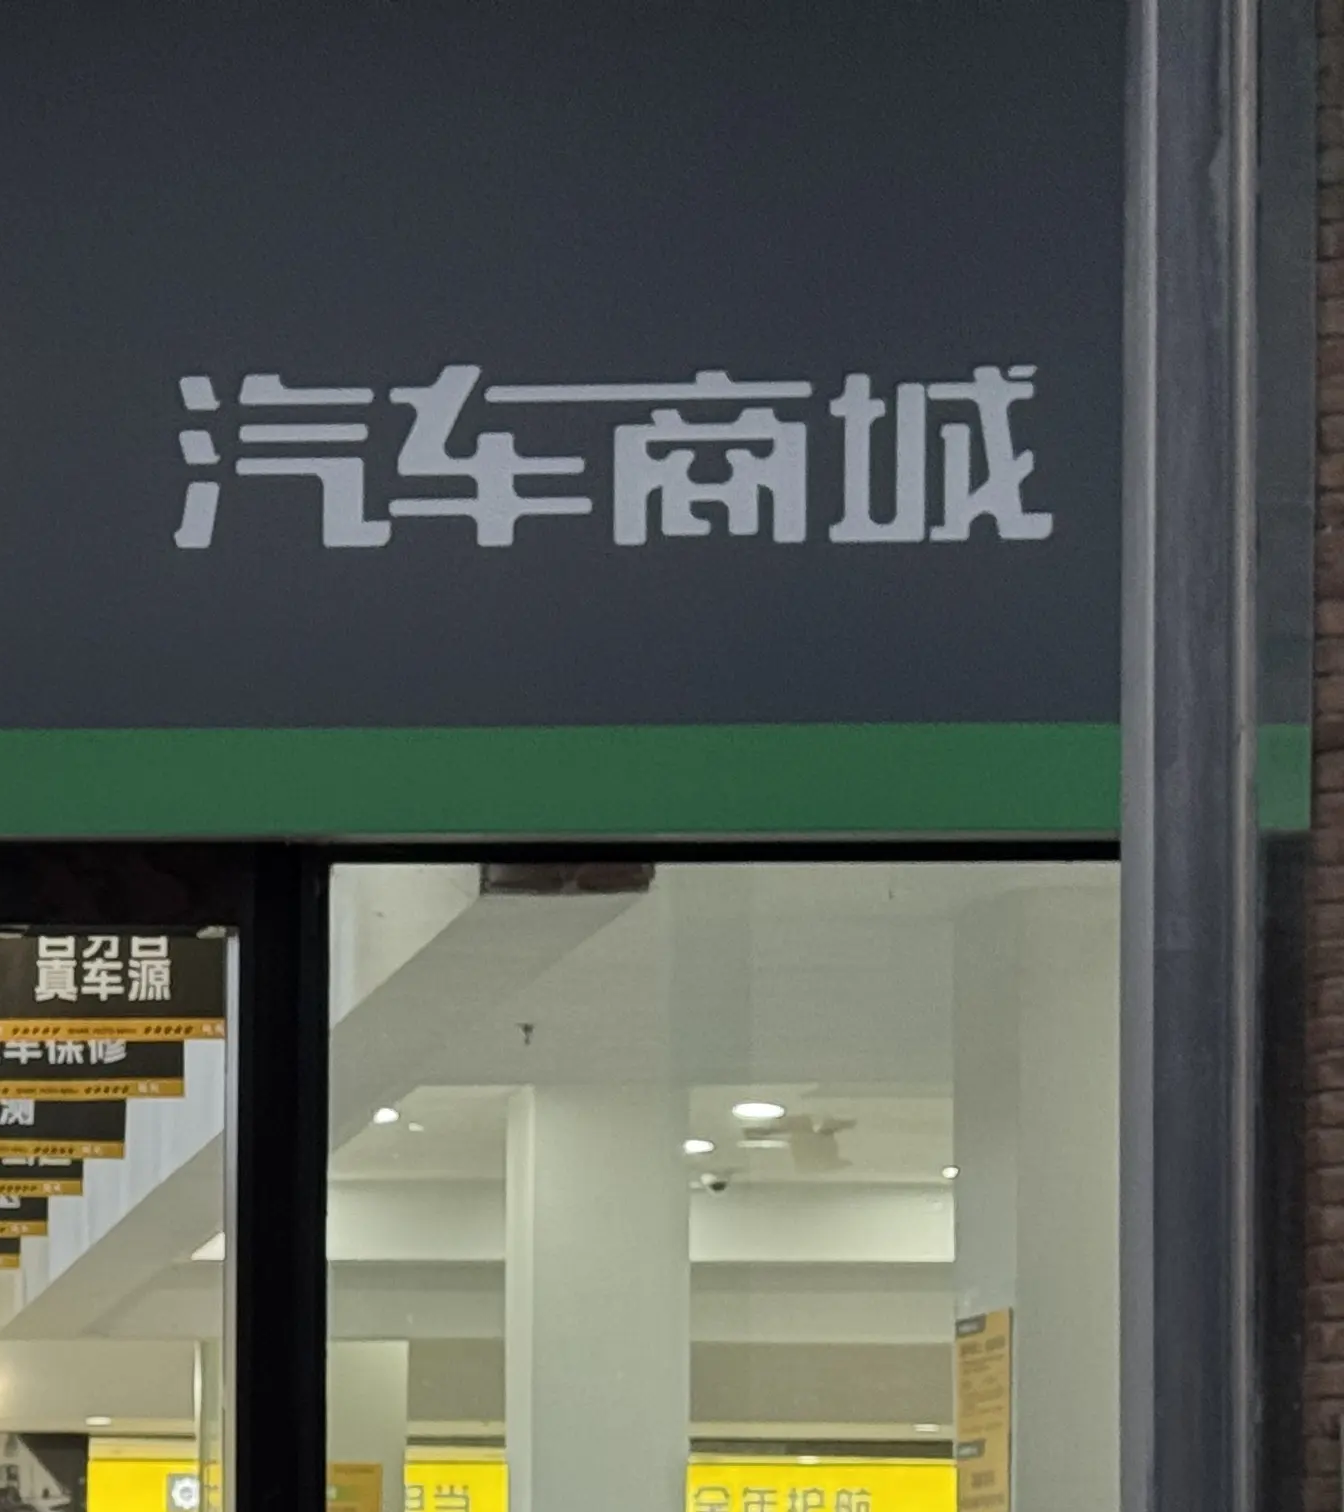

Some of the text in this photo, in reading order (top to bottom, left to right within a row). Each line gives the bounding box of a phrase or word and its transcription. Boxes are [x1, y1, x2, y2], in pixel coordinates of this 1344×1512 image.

[173, 364, 1054, 549] 汽车商城
[34, 959, 172, 1002] 真车源
